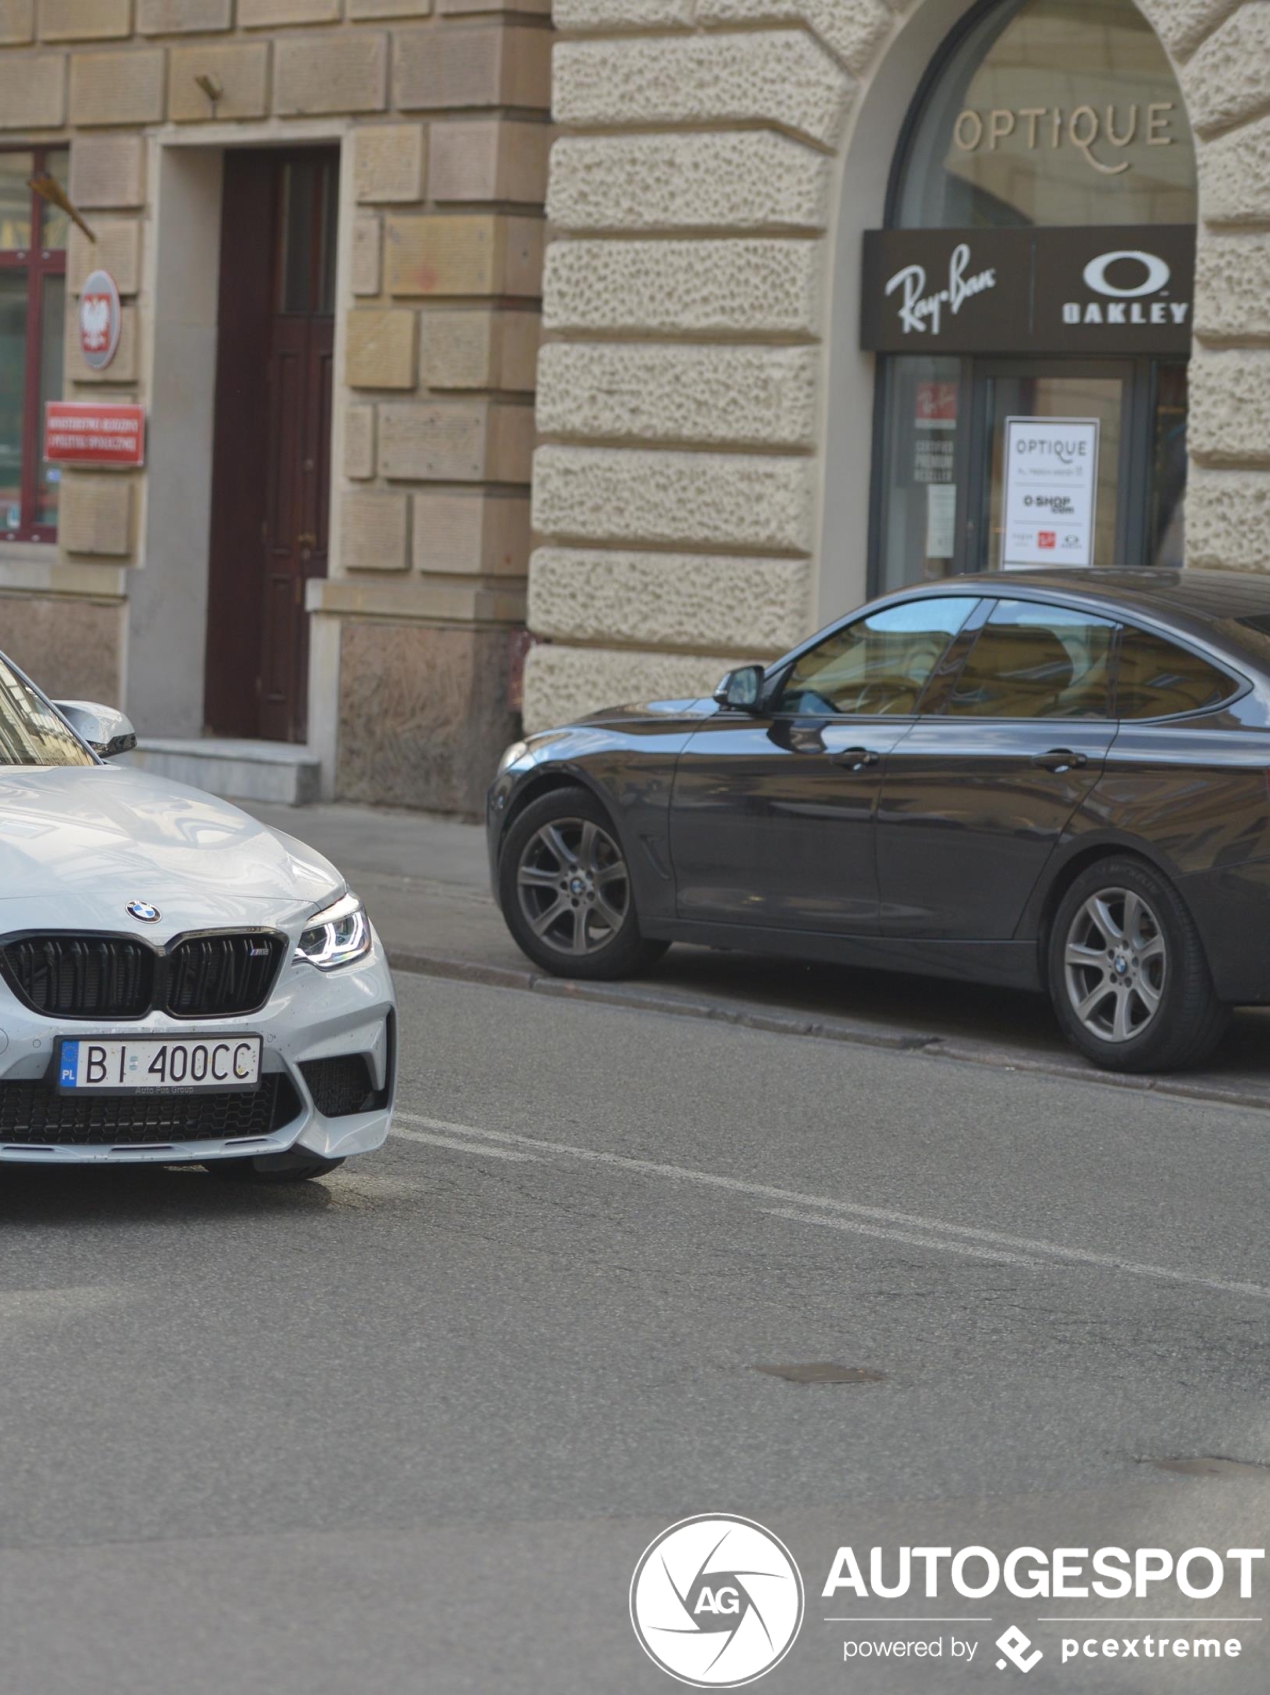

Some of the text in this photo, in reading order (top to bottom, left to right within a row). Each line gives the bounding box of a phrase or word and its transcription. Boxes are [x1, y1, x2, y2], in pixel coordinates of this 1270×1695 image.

[954, 103, 1173, 174] OPTIQUE
[1063, 302, 1190, 324] OAKLEY
[1016, 440, 1087, 464] OPTIQUE
[62, 1043, 251, 1083] PL BI 400CC
[135, 1086, 155, 1095] Auto
[171, 1085, 194, 1095] Group
